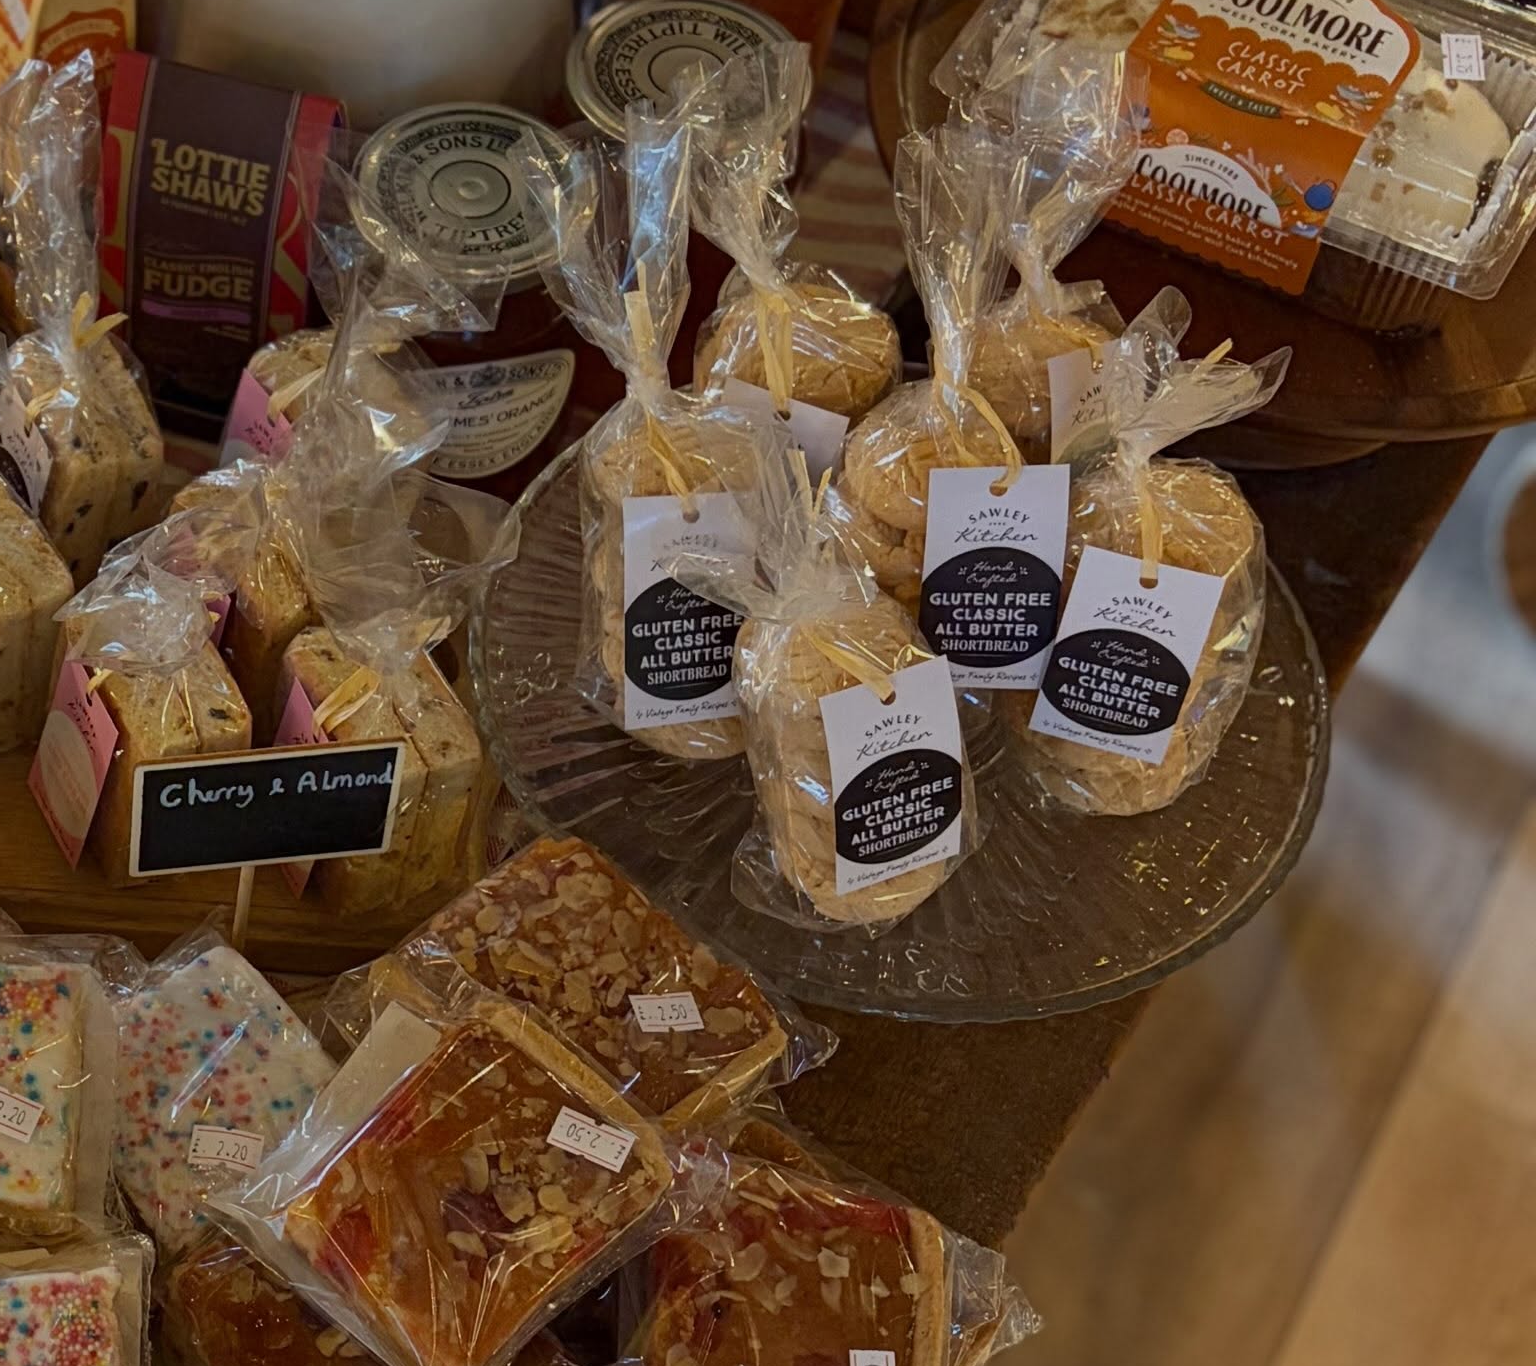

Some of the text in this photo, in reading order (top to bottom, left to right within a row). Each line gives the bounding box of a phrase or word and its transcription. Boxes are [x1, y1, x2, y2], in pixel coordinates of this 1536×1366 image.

[1221, 7, 1357, 60] WEST CORK BAKERY
[1217, 56, 1305, 95] CARROT
[1228, 41, 1312, 82] CLASSIC
[425, 136, 482, 156] SONS
[1184, 154, 1214, 166] SINCE
[151, 138, 271, 191] LOTTIE
[1135, 154, 1267, 221] COOLMORE
[1131, 175, 1288, 246] LASSIC CARROT
[144, 256, 254, 275] CLASSIC ENGLISH
[144, 269, 252, 301] FUDGE
[969, 507, 1030, 525] SAWLEY
[954, 526, 1039, 543] Kitchen
[930, 592, 1051, 606] GLUTEN FREE
[1112, 596, 1173, 619] SAWLEY
[632, 612, 744, 638] GLUTEN FREE
[953, 608, 1026, 621] CLASSIC
[1094, 607, 1176, 638] Kitchen
[655, 631, 721, 651] CLASSIC
[935, 623, 1038, 637] ALL BUTTER
[641, 646, 733, 670] ALL BUTTER
[941, 639, 1029, 652] SHORTBREAD
[647, 664, 727, 685] SHORTBREAD
[1058, 657, 1179, 697] GLUTEN FREE
[1058, 683, 1160, 719] ALL BUTTER
[1078, 676, 1151, 703] CLASSIC
[675, 704, 699, 716] Family
[1062, 697, 1149, 729] SHORTBREAD
[866, 713, 922, 738] SAWLEY
[857, 731, 932, 761] Kitchen
[160, 778, 254, 808] Cherry
[269, 778, 284, 795] &
[842, 776, 954, 821] GLUTEN FREE
[851, 806, 945, 846] ALL BUTTER
[866, 797, 932, 827] CLASSIC
[858, 822, 938, 857] SHORTBREAD
